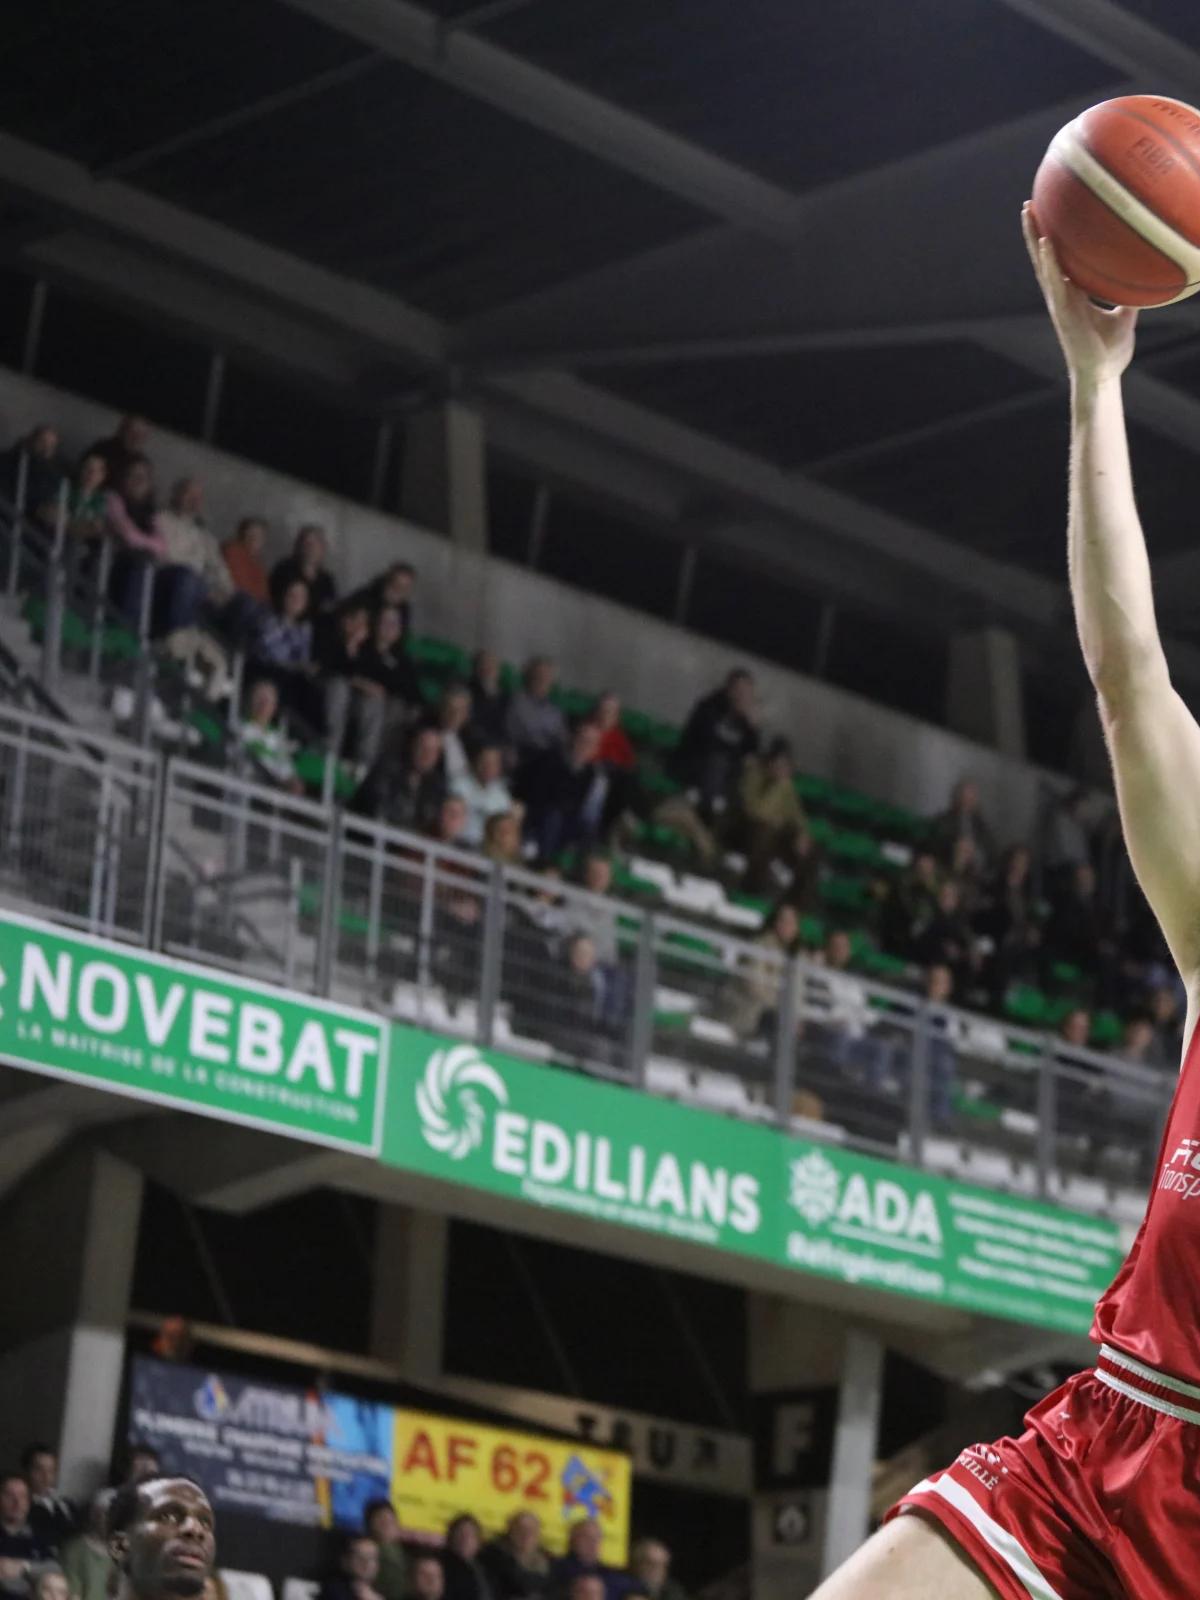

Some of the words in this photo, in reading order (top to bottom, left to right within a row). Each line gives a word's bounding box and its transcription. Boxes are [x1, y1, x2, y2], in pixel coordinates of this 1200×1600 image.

[19, 942, 378, 1099] NOVEBAT
[151, 1058, 176, 1077] DE
[182, 1064, 208, 1086] LA
[214, 1070, 358, 1123] CONSTRUCTION
[493, 1110, 761, 1234] EDILIANS
[839, 1174, 942, 1244] ADA
[402, 1429, 478, 1482] AF
[490, 1444, 551, 1501] 62
